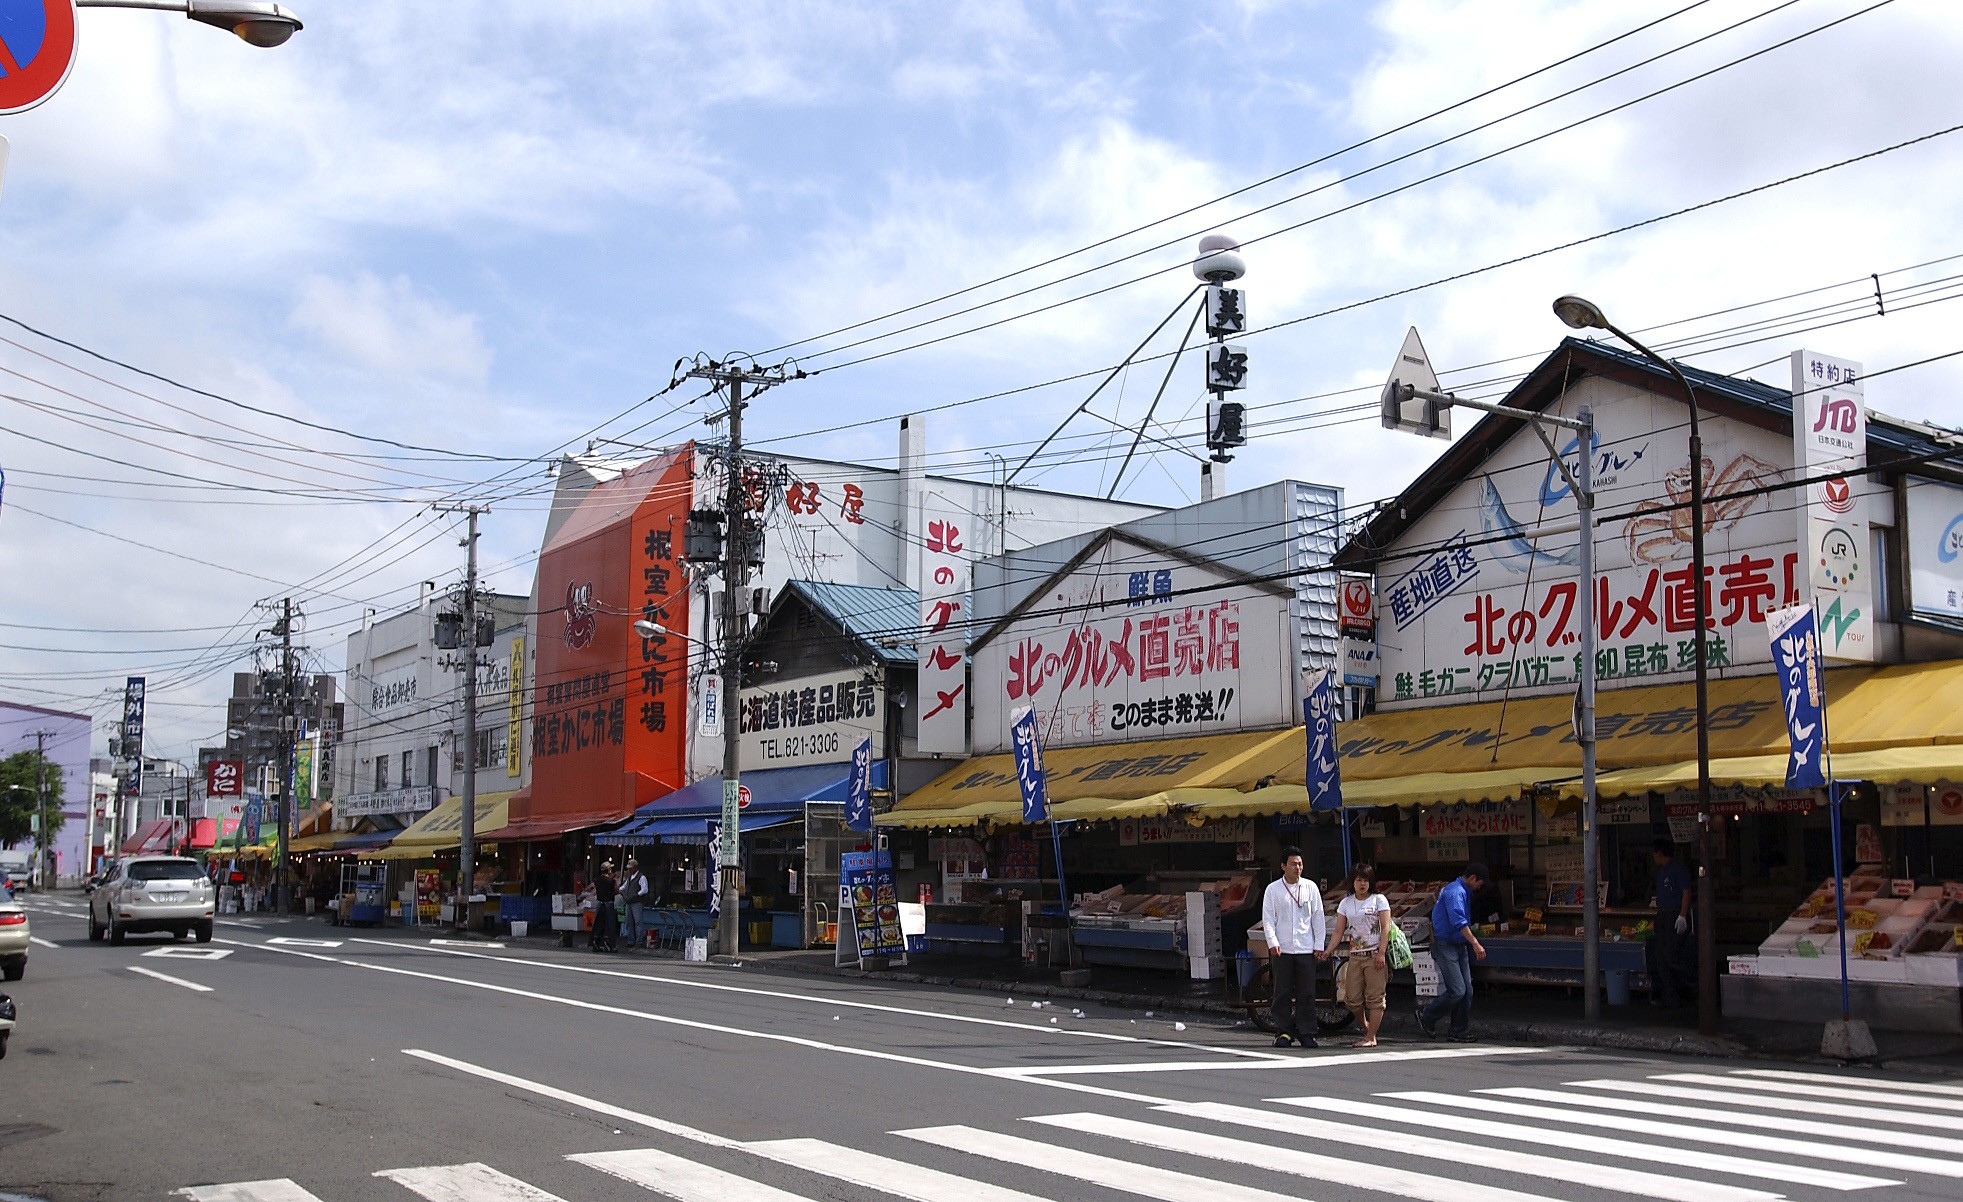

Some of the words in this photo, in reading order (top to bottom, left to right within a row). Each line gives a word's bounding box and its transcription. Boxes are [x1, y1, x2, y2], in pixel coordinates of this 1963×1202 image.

[1211, 288, 1248, 443] 美好屋
[1810, 360, 1856, 387] 特約店
[1813, 394, 1857, 434] JTB
[1831, 543, 1847, 558] JR
[1127, 569, 1173, 608] 鮮魚
[1389, 537, 1478, 626] 産地直送
[922, 518, 965, 722] 北のグルメ
[1006, 600, 1240, 701] 北のグルメ直売店
[1348, 649, 1365, 661] ANA
[212, 764, 237, 793] かに
[841, 886, 849, 903] P
